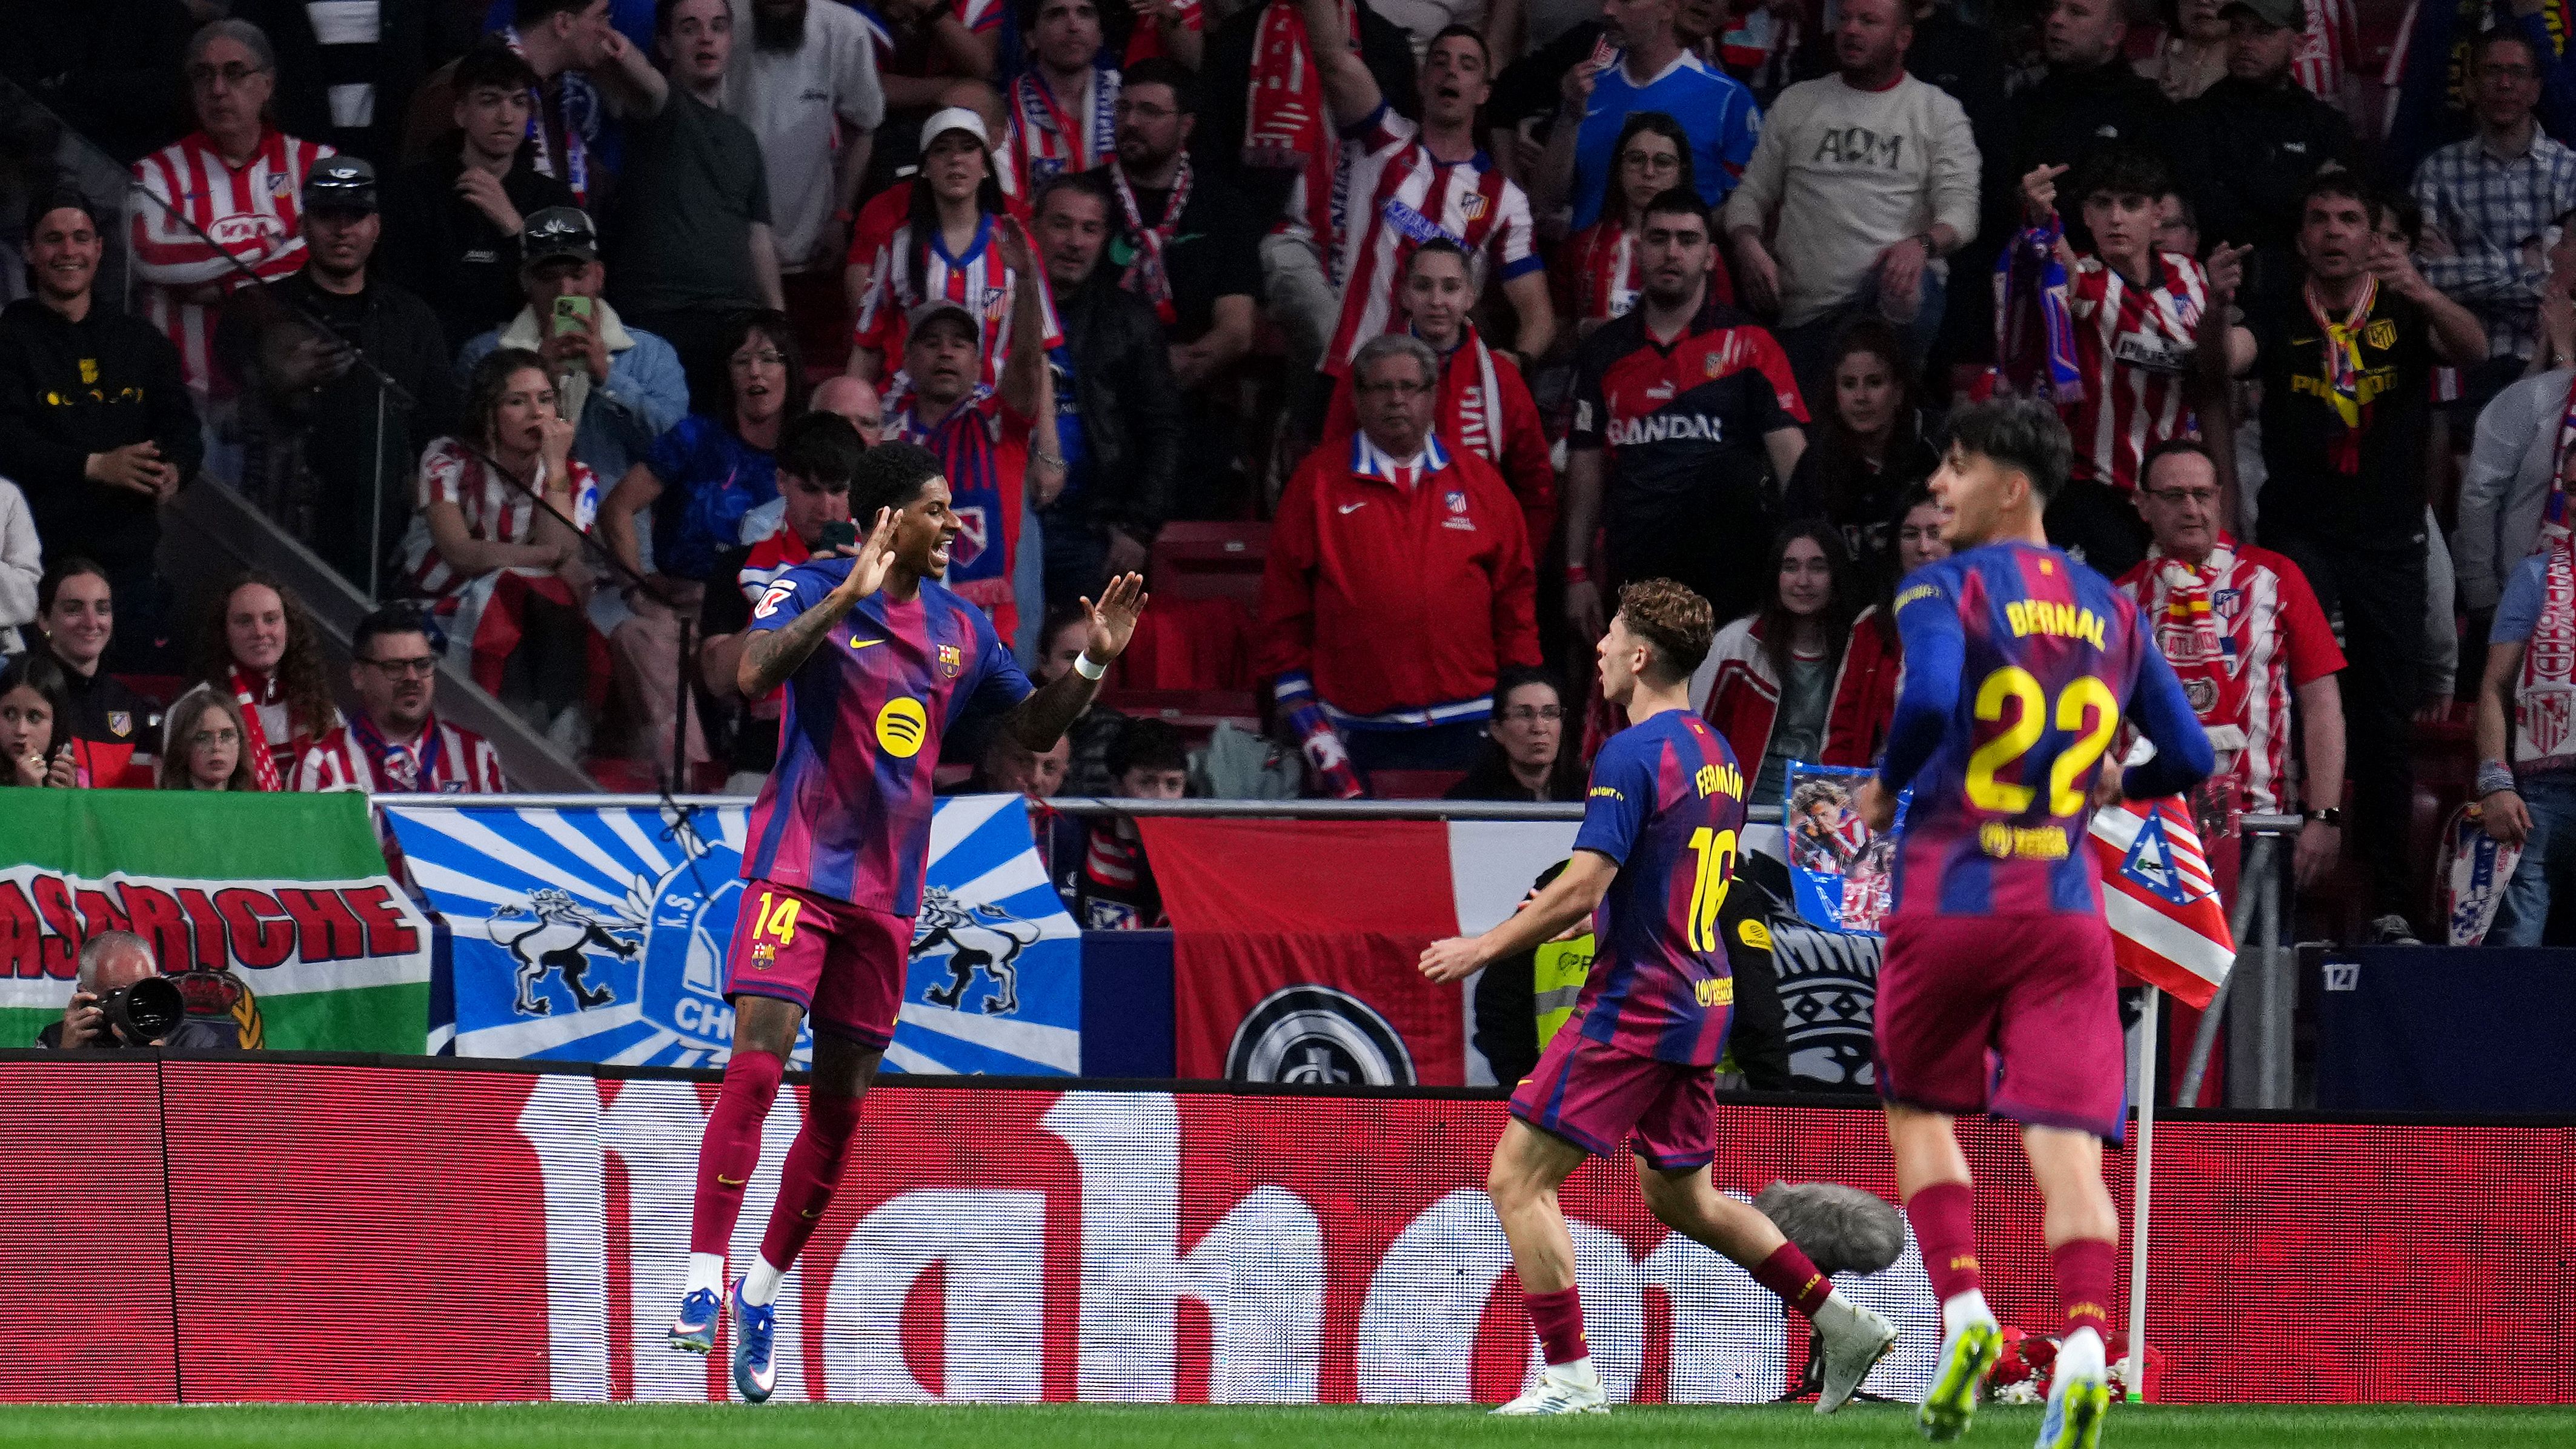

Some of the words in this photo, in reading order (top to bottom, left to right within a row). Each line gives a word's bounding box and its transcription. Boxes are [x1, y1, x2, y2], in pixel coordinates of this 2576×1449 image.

[1606, 413, 1722, 445] BANDAI
[2005, 598, 2106, 652] BERNAL
[1966, 665, 2120, 818] 22
[1695, 762, 1744, 803] FERMÍN
[1687, 826, 1738, 953] 16
[752, 892, 802, 946] 14
[2322, 964, 2361, 990] 127
